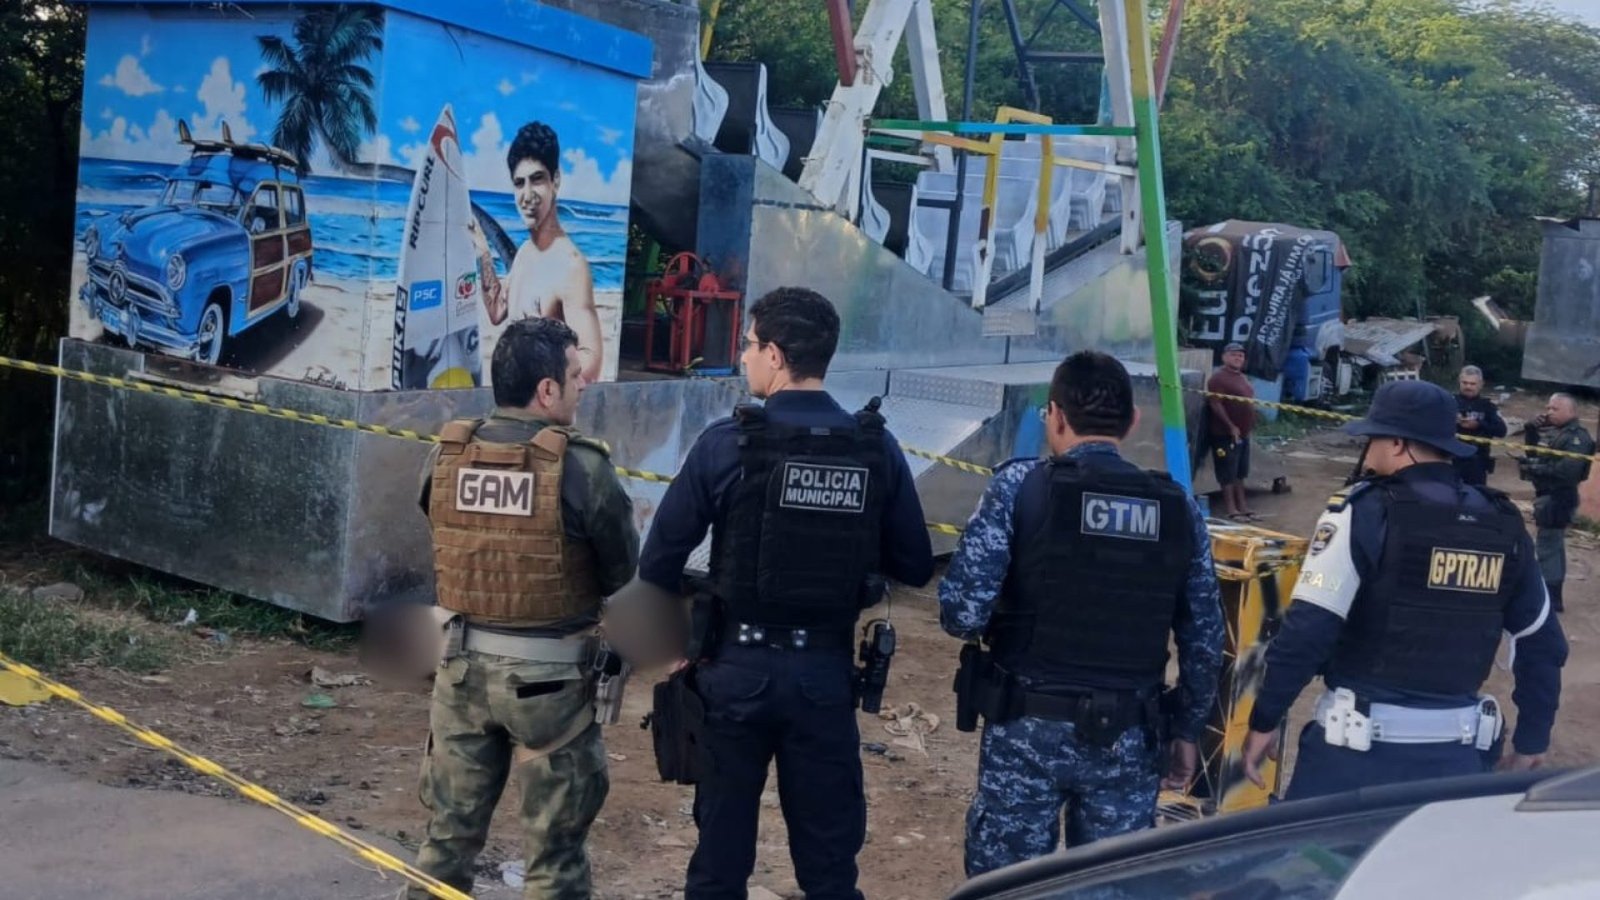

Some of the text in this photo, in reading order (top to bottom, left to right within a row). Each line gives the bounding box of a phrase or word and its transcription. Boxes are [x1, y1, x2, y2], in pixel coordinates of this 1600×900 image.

[414, 287, 438, 302] PSC
[459, 473, 531, 510] GAM
[785, 488, 861, 507] MUNICIPAL
[1085, 498, 1157, 535] GTM
[1431, 552, 1502, 590] GPTRAN
